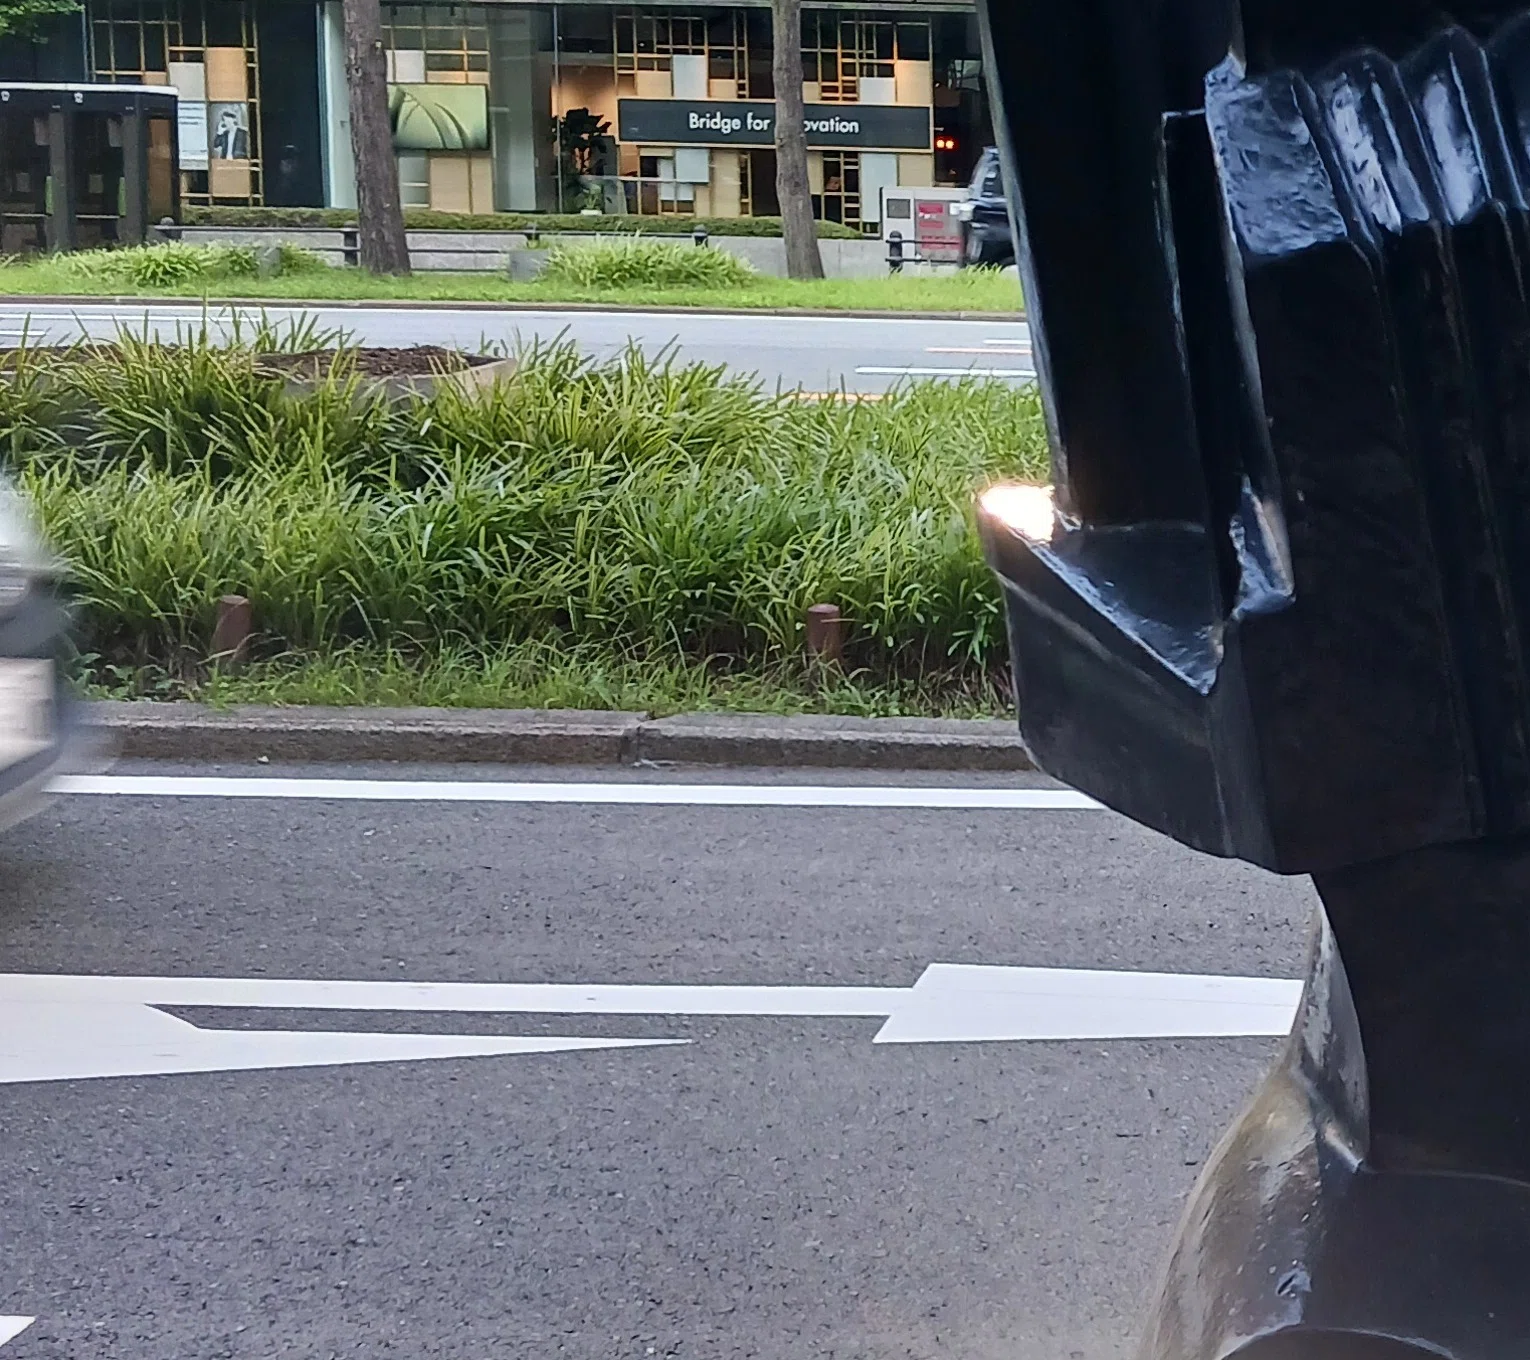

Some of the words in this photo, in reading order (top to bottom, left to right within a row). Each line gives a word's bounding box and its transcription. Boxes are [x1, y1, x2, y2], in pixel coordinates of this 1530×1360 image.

[688, 112, 741, 134] Bridge
[747, 112, 771, 131] for
[803, 116, 860, 134] ovation
